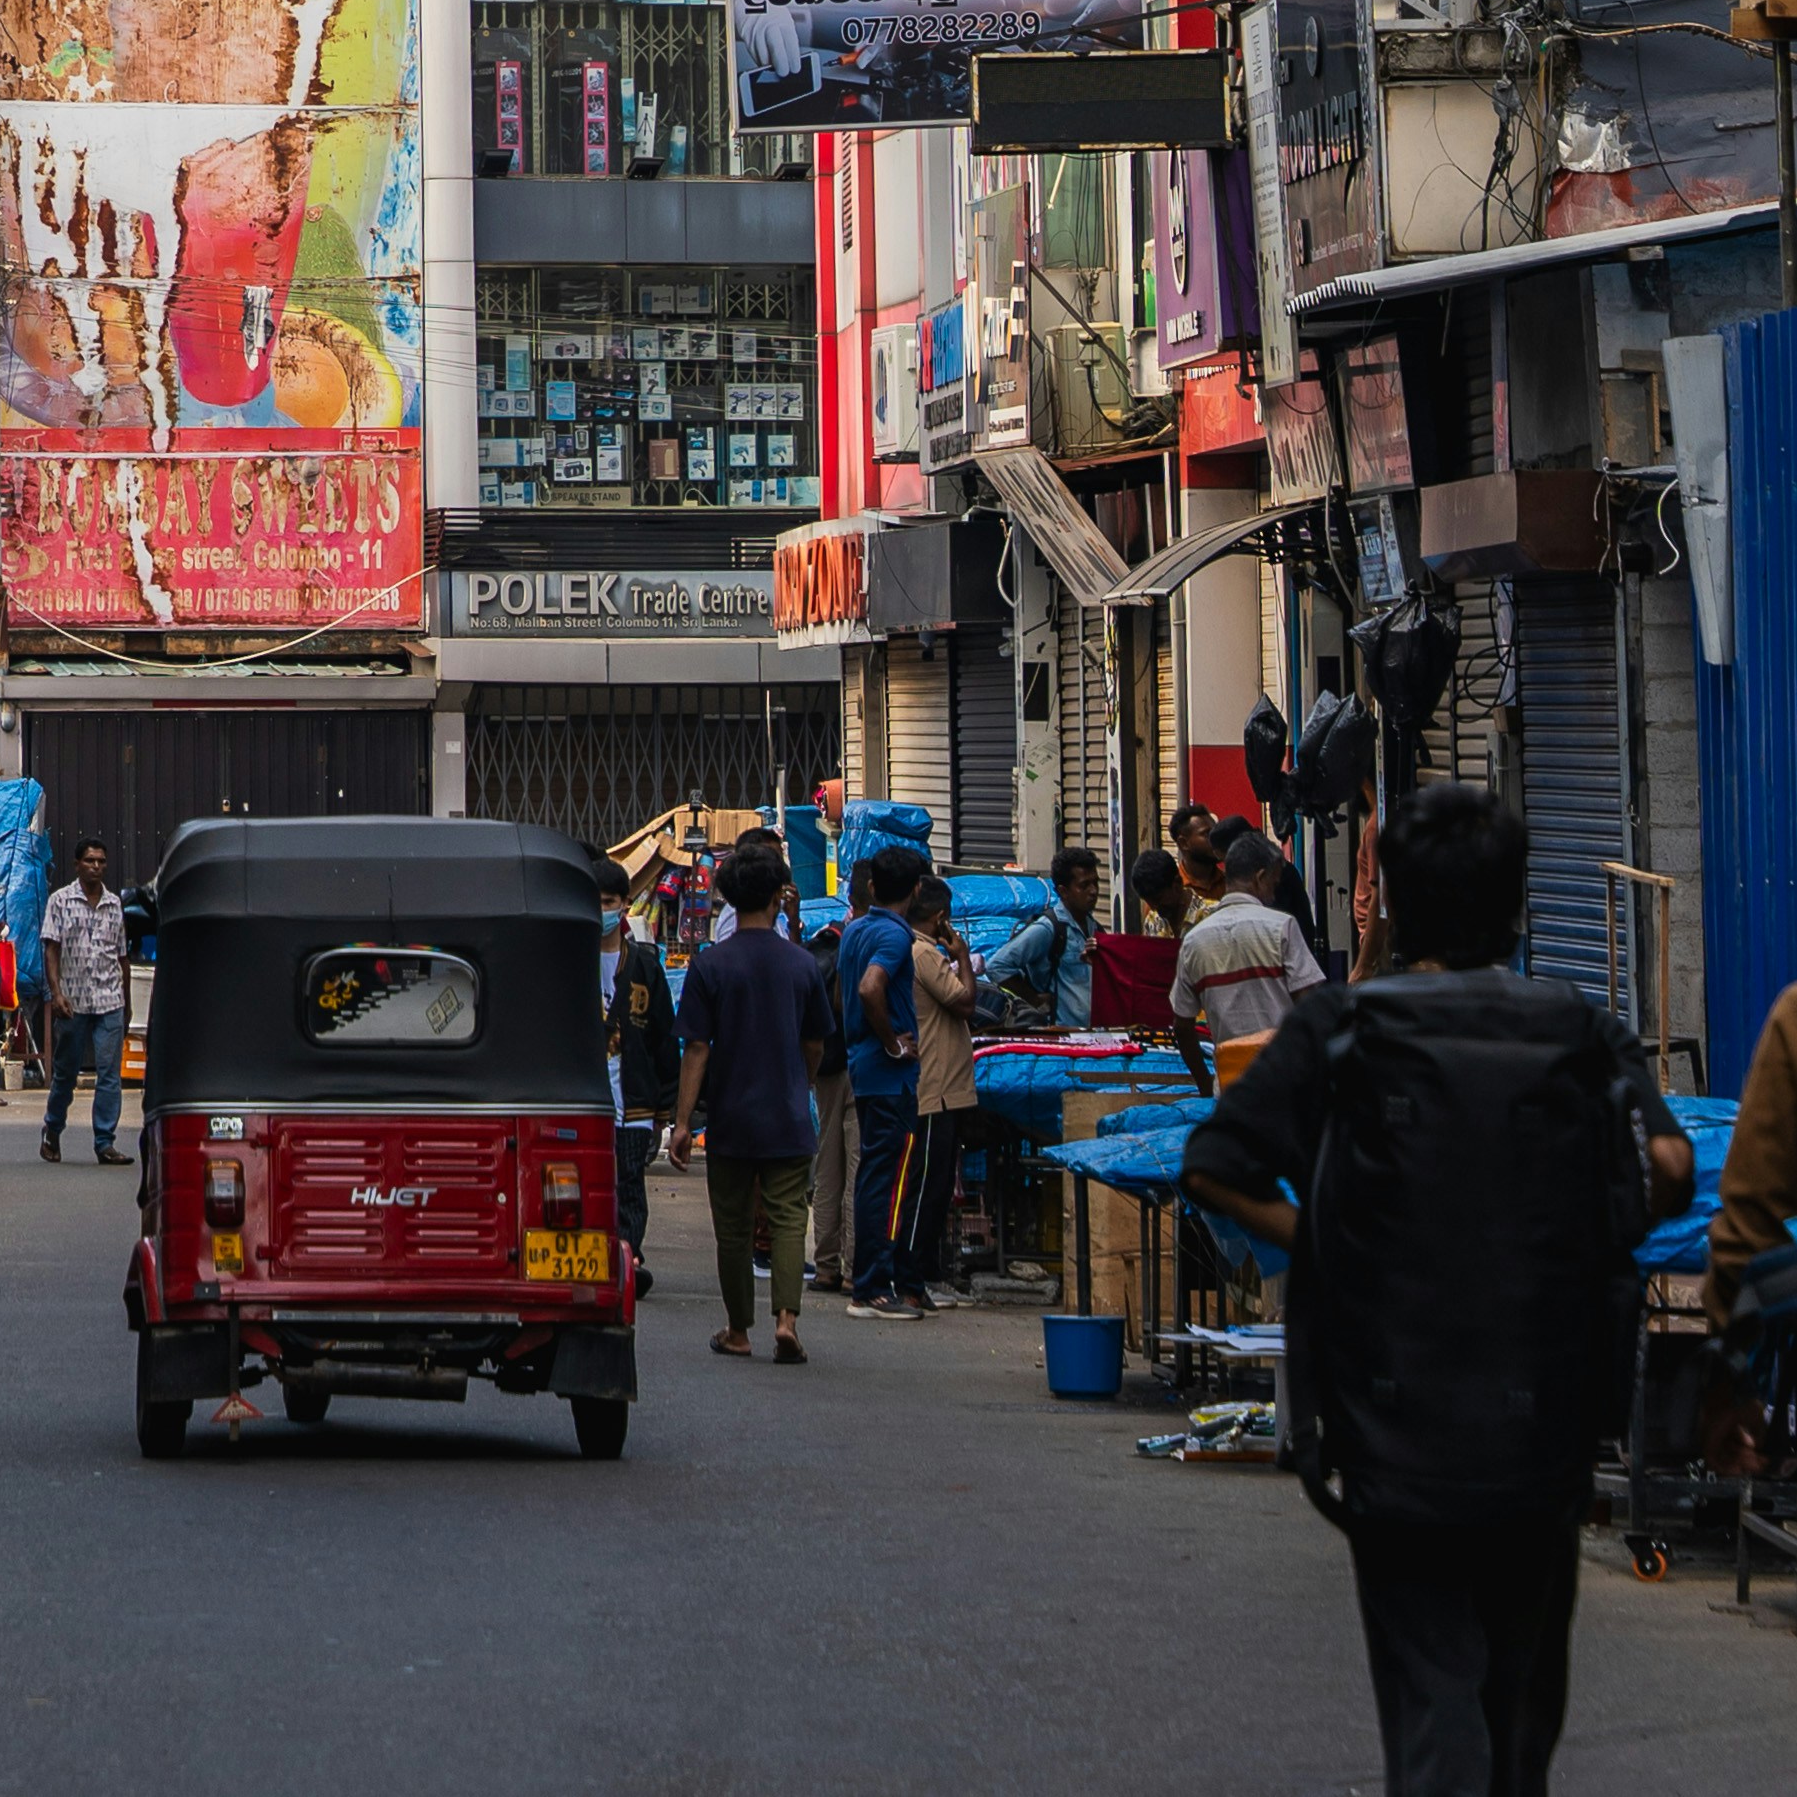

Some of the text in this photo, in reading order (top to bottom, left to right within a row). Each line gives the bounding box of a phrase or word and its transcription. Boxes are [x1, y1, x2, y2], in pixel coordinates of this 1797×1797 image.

[842, 12, 1042, 46] 0778282289
[231, 457, 401, 537] SWEETS
[592, 492, 620, 502] STAND
[254, 539, 342, 570] Colombo
[359, 539, 382, 569] 11
[469, 573, 767, 615] POLEK Trade Centre
[514, 617, 561, 629] Maliban
[565, 617, 601, 629] Street
[606, 616, 658, 629] Colombo
[662, 617, 678, 630] 11,
[555, 1232, 582, 1255] QT
[552, 1257, 598, 1278] 3129
